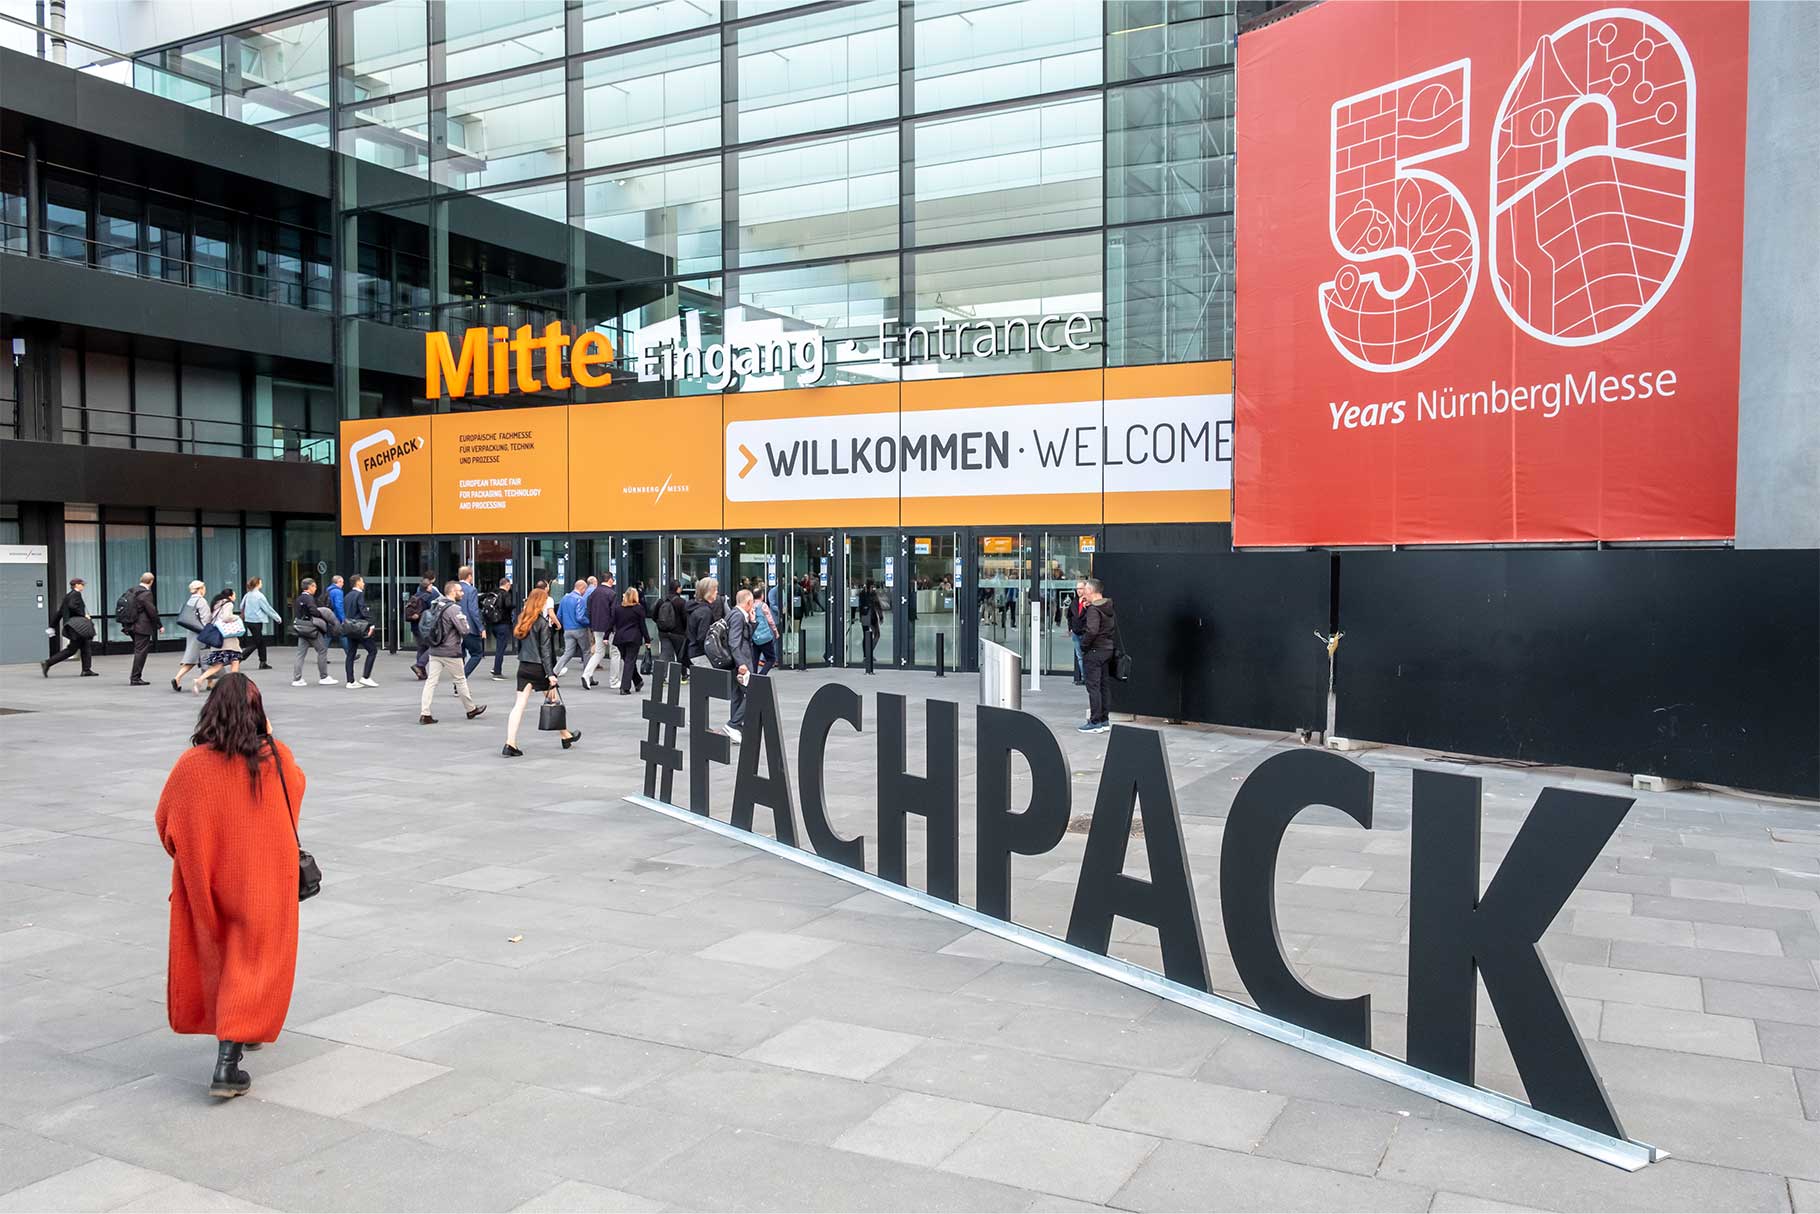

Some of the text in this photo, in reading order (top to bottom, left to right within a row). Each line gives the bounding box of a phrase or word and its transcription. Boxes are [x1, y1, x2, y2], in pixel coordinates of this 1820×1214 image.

[1318, 7, 1697, 373] 50
[425, 311, 1094, 399] Mitte Eingang Entrance
[1329, 368, 1677, 430] Years NürnbergMesse
[499, 431, 532, 440] FACHMESSE
[510, 442, 535, 451] TECHNIK
[765, 419, 1233, 477] WILLKOMMEN WELCOME
[363, 438, 418, 472] FACHPACK
[459, 455, 500, 464] UND PROZESSE
[459, 477, 522, 488] EUROPEAN TRADE FAIR
[459, 490, 471, 499] FOR
[504, 488, 542, 497] TECHNOLOGY
[667, 485, 689, 493] MESSE
[459, 501, 506, 510] AND PROCESSING
[640, 660, 1635, 1142] #FACHPACK
